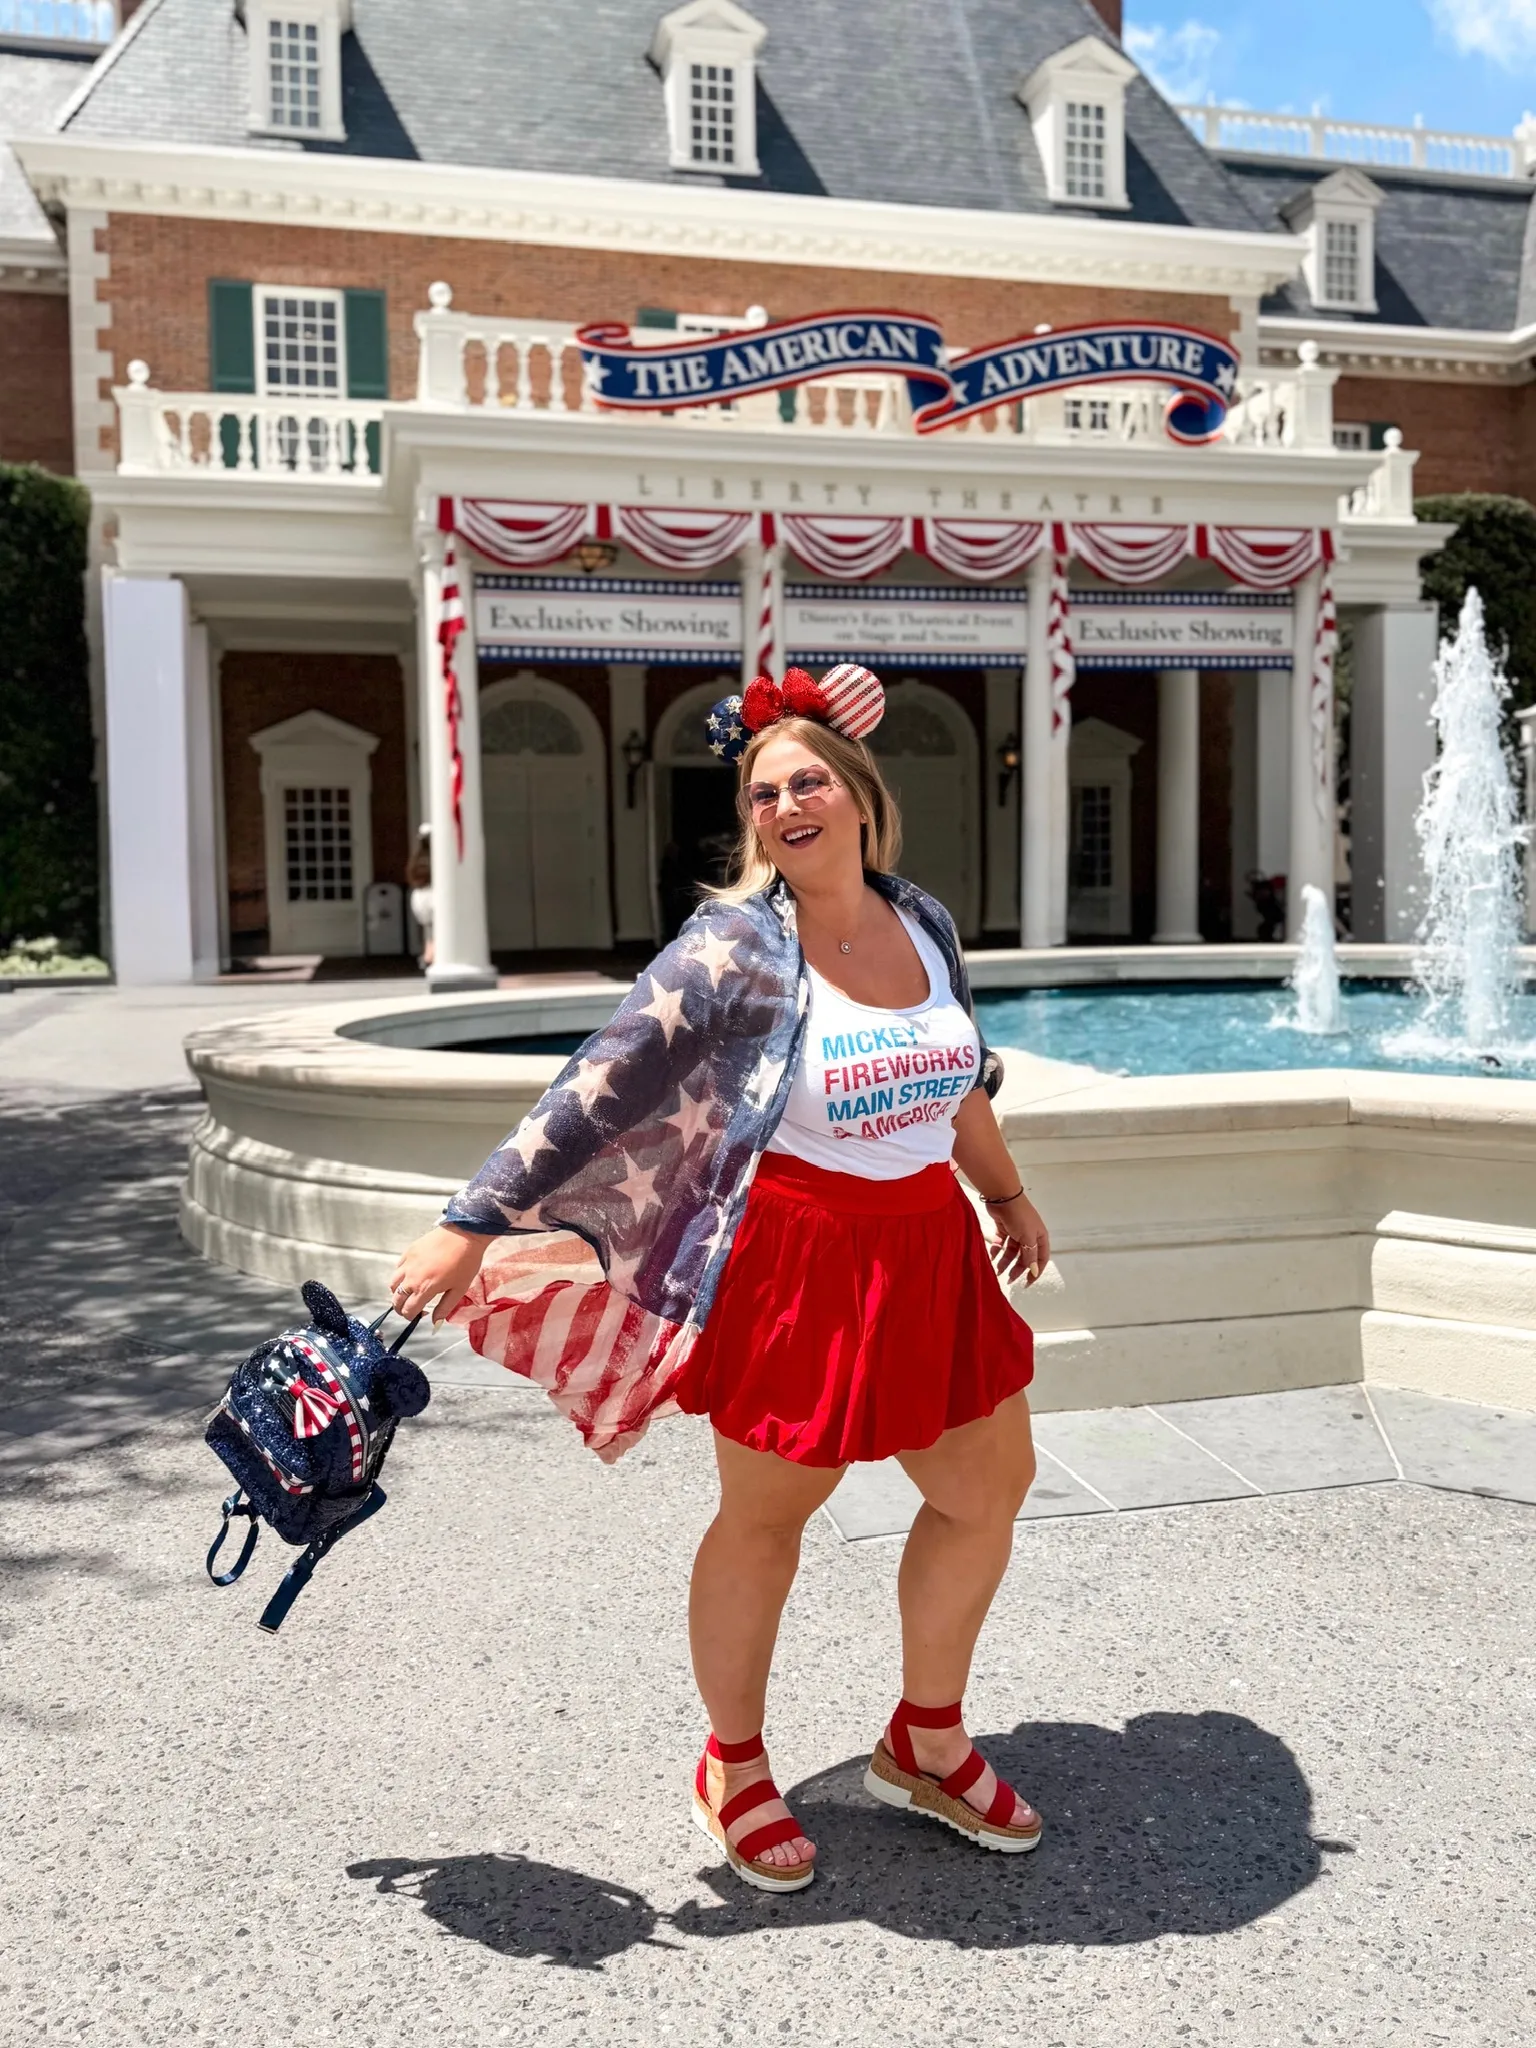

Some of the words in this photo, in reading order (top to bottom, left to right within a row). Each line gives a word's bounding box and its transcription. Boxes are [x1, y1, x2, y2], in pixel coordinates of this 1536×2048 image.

[626, 355, 713, 396] THE
[720, 325, 919, 386] AMERICAN
[980, 335, 1205, 397] ADVENTURE
[637, 474, 872, 506] LIBERTY
[927, 488, 1164, 515] THEATRE
[489, 605, 612, 633] Exclusive
[620, 608, 730, 639] Showing
[1078, 619, 1182, 642] Exclusive
[1189, 621, 1283, 645] Showing
[822, 1025, 919, 1061] MICKEY
[824, 1045, 975, 1095] FIREWORKS
[826, 1087, 893, 1122] MAIN
[898, 1074, 974, 1105] STREET
[861, 1101, 952, 1140] AMERICA
